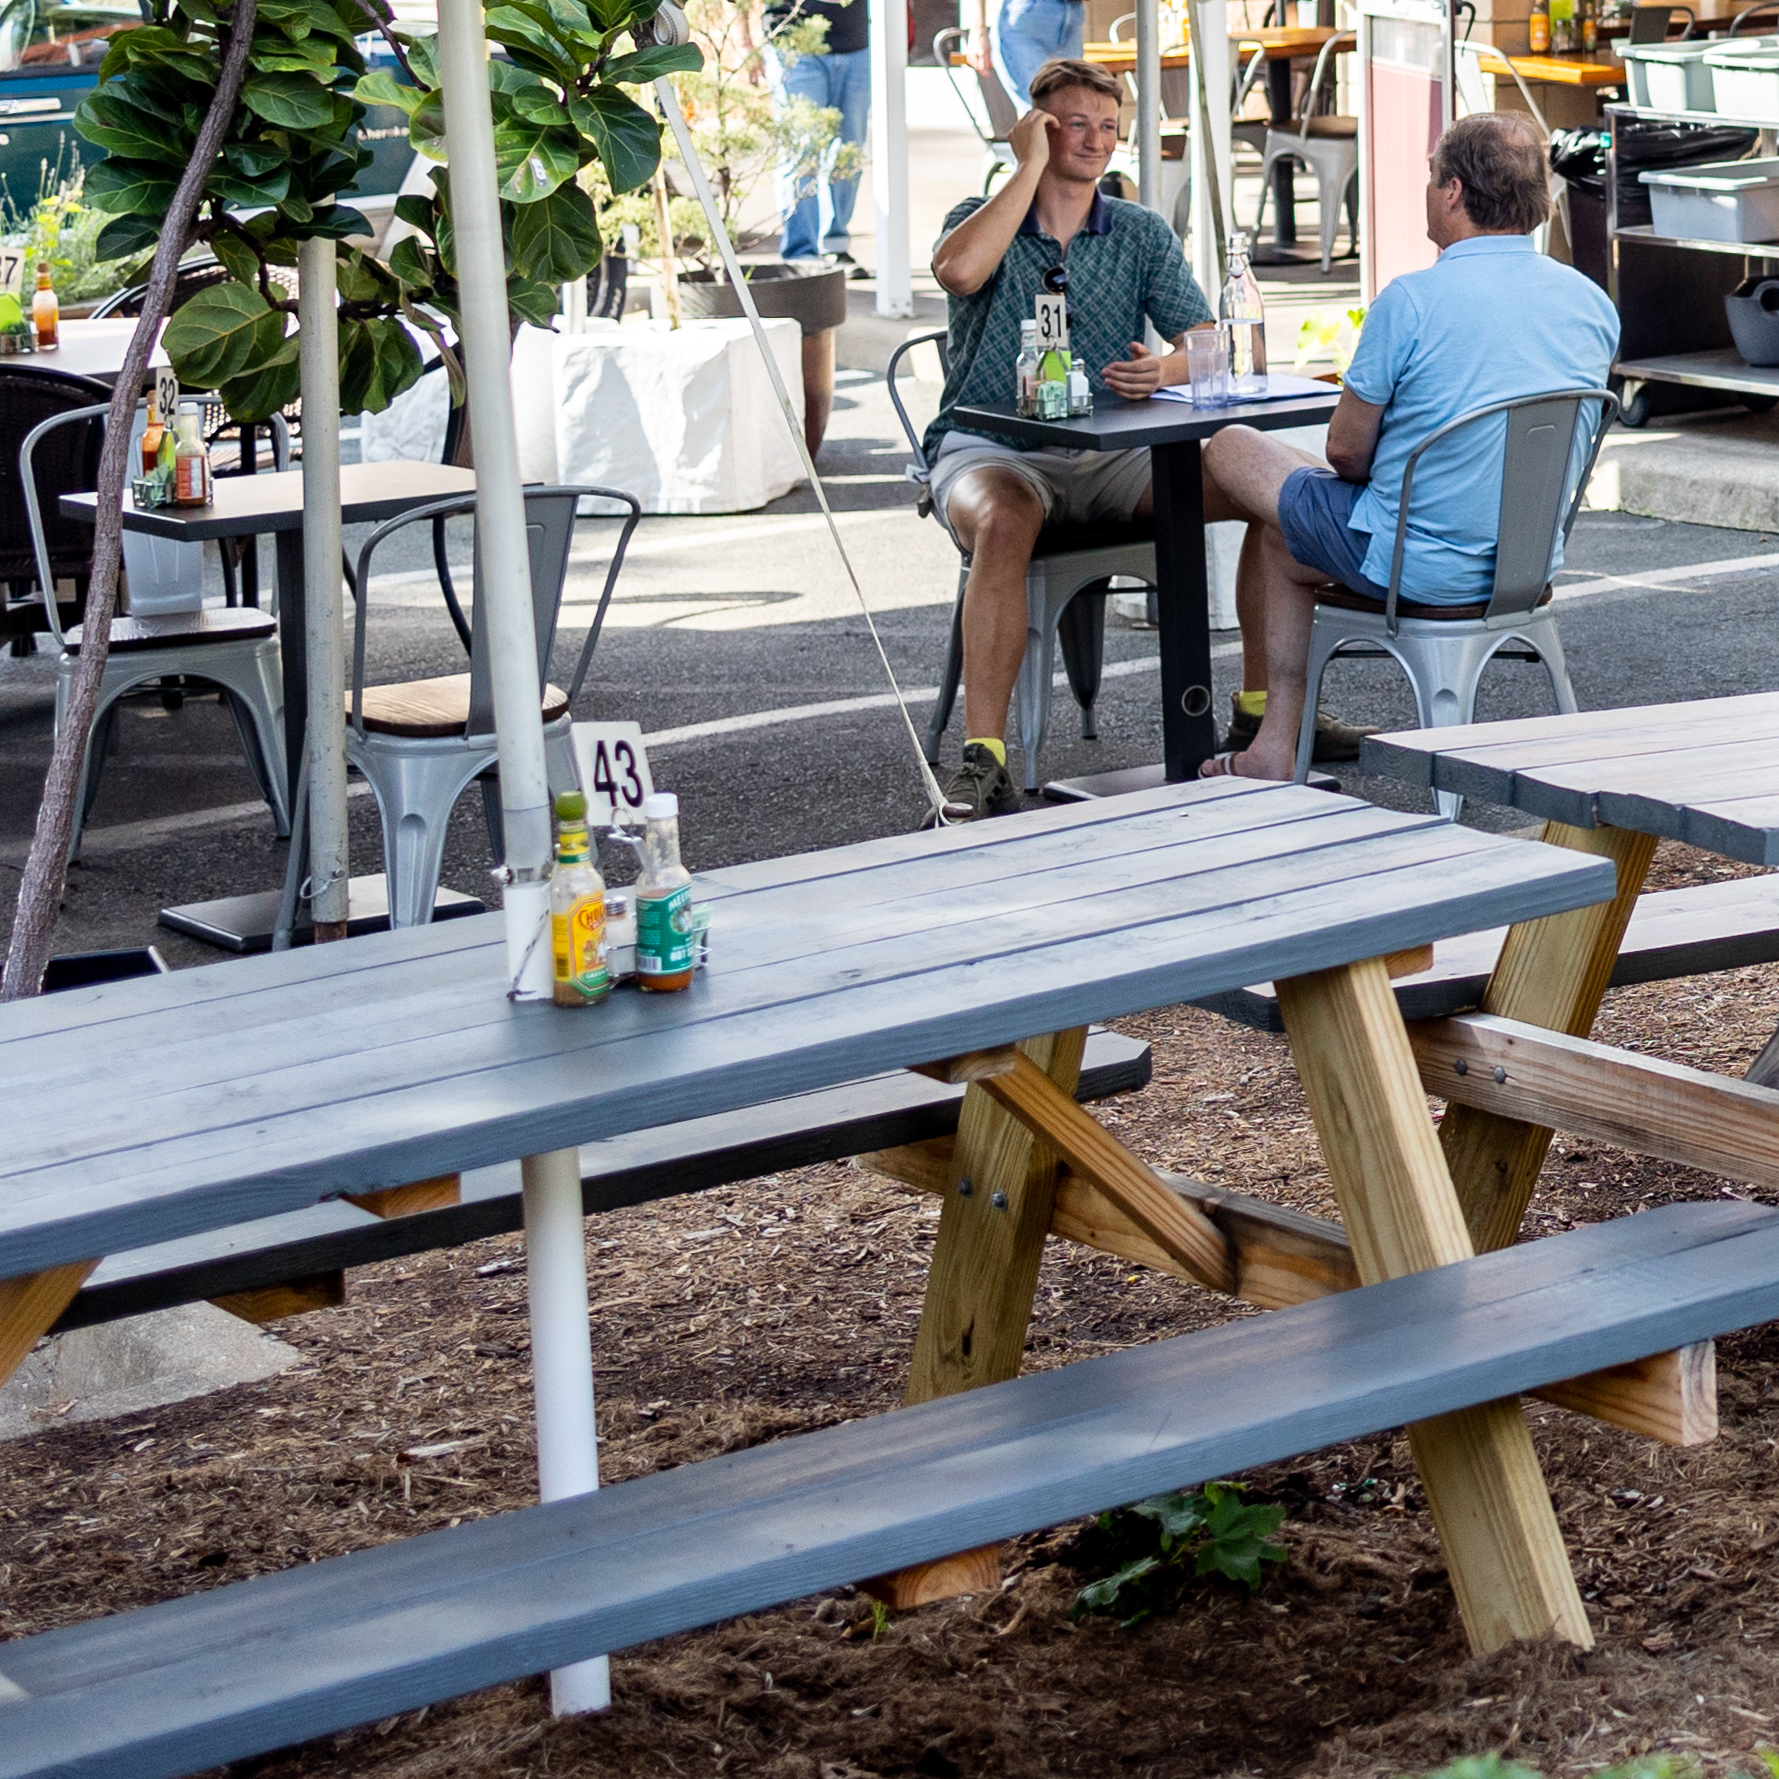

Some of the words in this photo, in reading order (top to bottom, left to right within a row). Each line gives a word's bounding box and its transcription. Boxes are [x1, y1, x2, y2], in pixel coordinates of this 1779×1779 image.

[1040, 303, 1062, 339] 31
[159, 376, 176, 416] 32
[593, 739, 644, 809] 43
